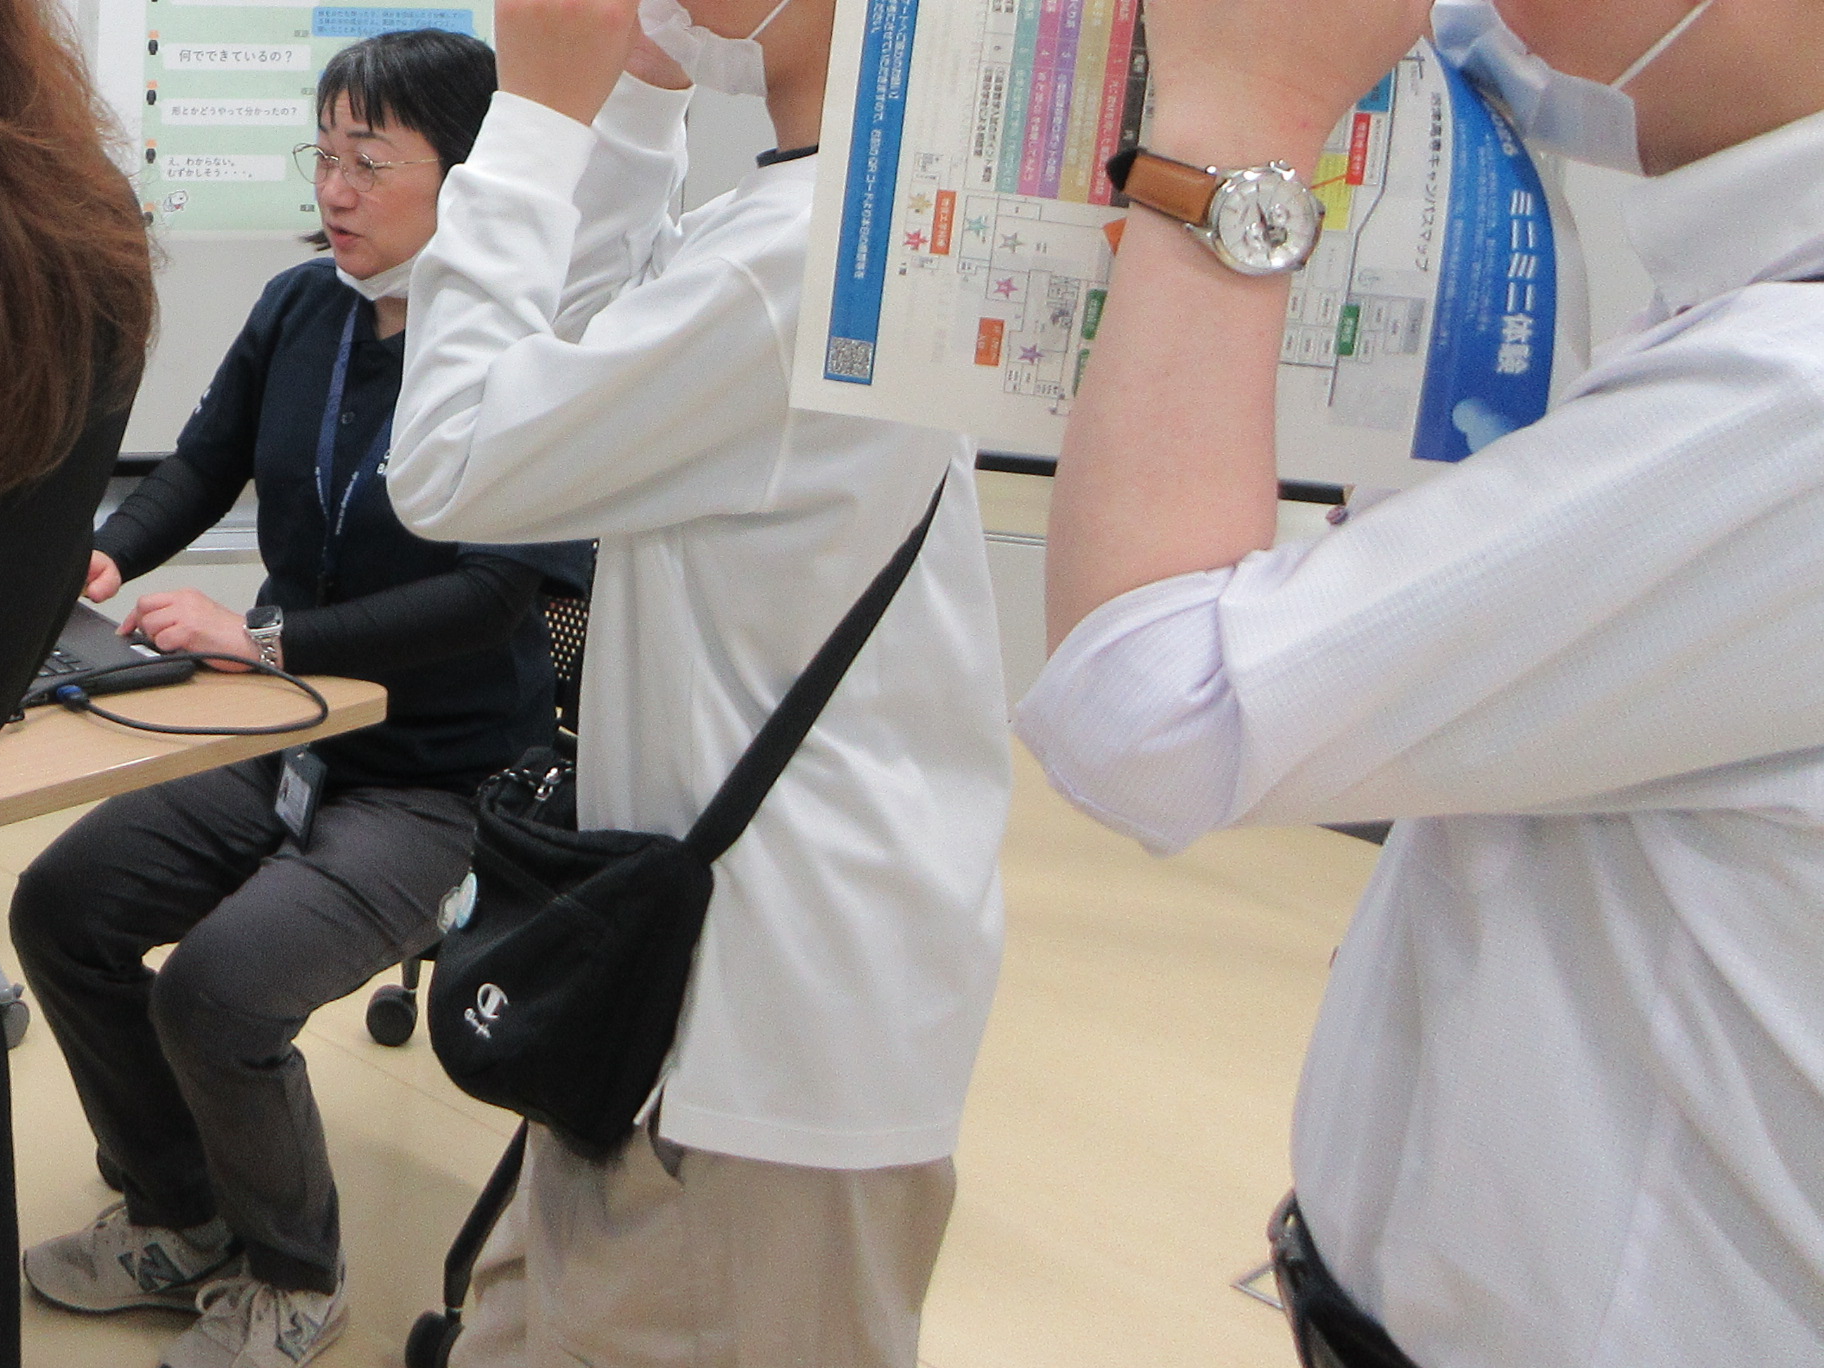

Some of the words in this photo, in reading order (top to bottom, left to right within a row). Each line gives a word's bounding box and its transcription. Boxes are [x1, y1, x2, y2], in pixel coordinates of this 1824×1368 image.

[179, 49, 294, 64] 何でできているの？
[171, 105, 298, 117] 形とかどうやって分かったの？
[1495, 188, 1536, 376] ミニミニ体験
